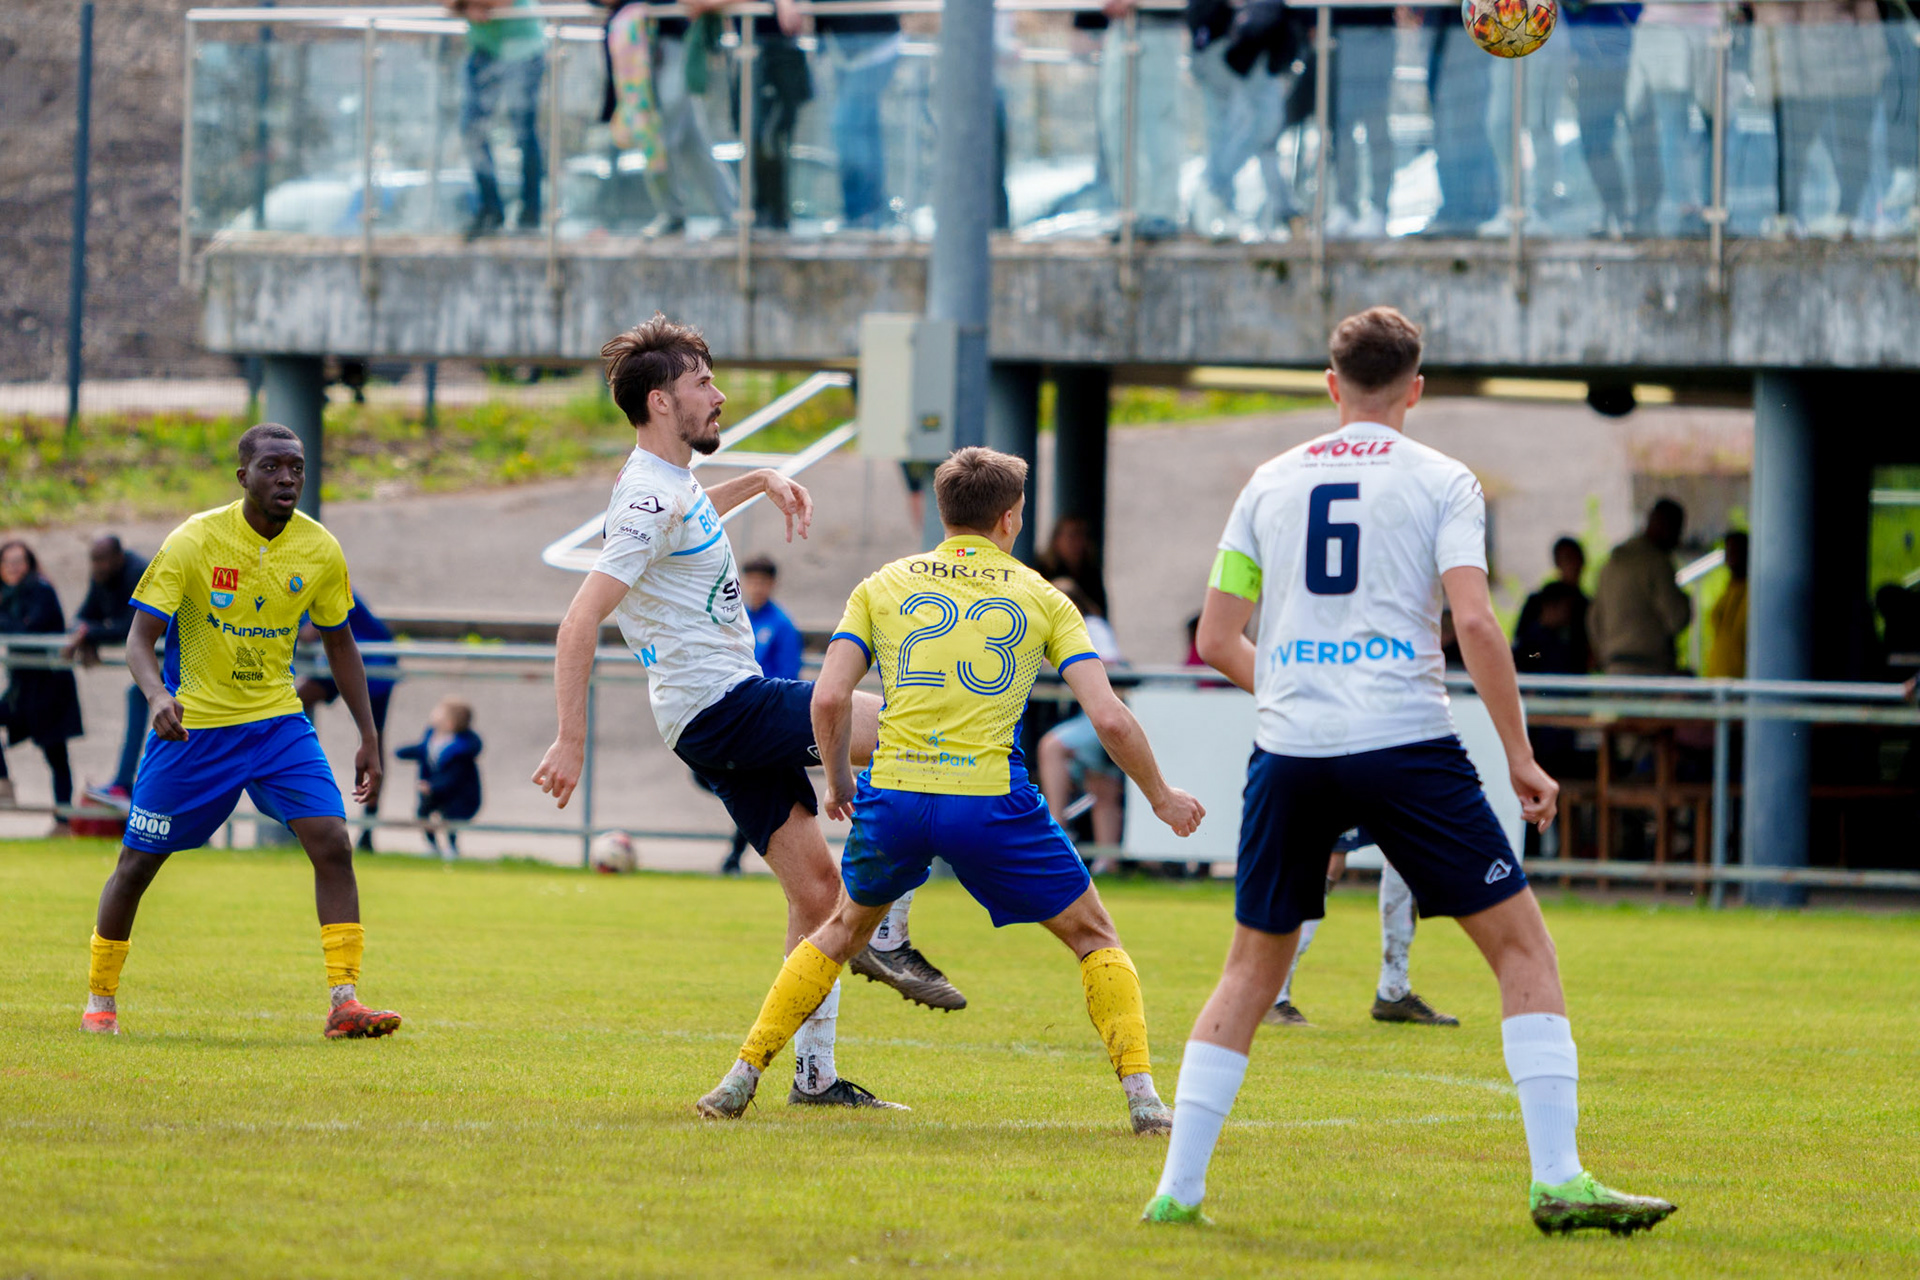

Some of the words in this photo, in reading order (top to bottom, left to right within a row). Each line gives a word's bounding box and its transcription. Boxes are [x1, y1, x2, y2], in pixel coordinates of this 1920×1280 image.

[1306, 483, 1360, 596] 6
[896, 592, 1028, 696] 23
[895, 748, 977, 768] LEDsPark
[129, 811, 171, 835] 2000
